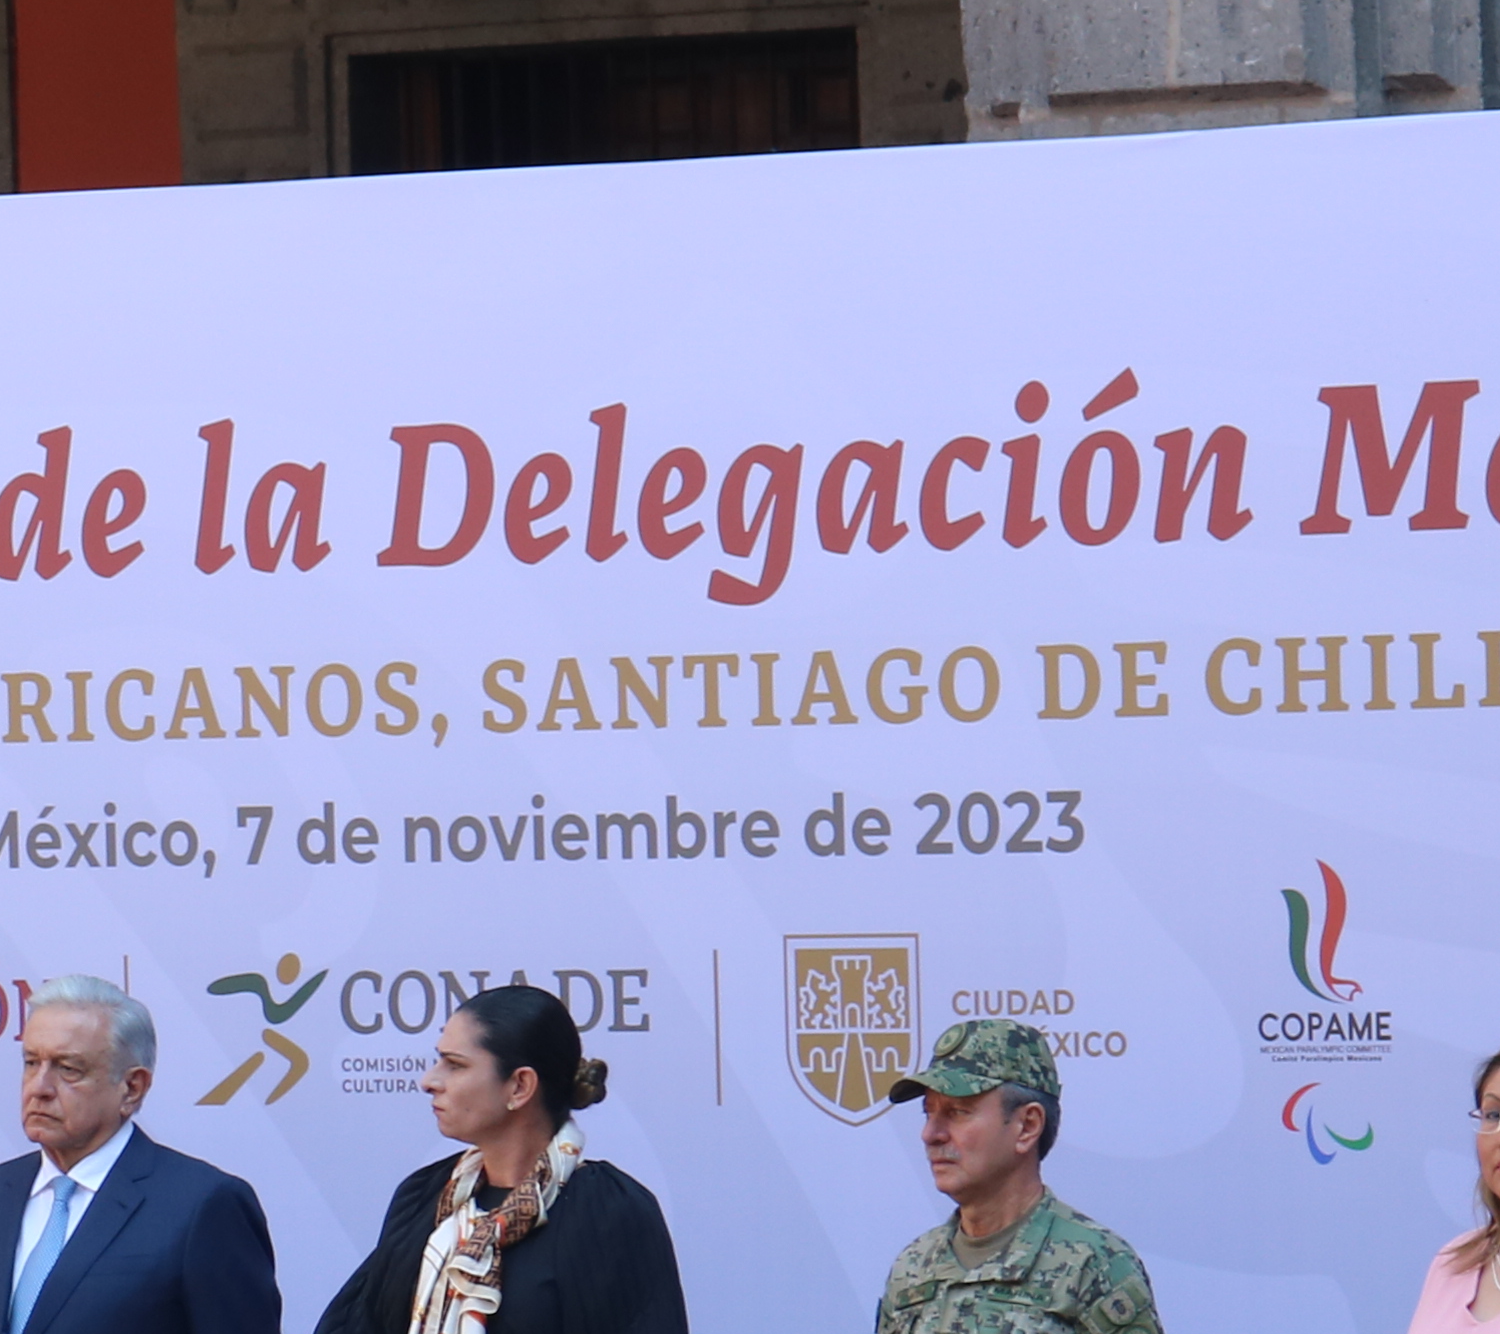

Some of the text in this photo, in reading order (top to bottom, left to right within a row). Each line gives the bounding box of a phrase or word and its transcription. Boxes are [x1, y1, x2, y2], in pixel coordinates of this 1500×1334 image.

[193, 417, 333, 576] la
[375, 365, 1254, 607] Delegación
[482, 645, 1001, 734] SANTIAGO
[1035, 640, 1170, 721] DE
[236, 805, 275, 866] 7
[296, 801, 380, 866] de
[403, 793, 782, 864] noviembre
[803, 791, 892, 858] de
[912, 790, 1085, 856] 2023
[339, 968, 650, 1035] CONDE
[951, 989, 1076, 1017] CIUDAD
[1037, 1024, 1128, 1058] XICO
[1257, 1011, 1393, 1042] COPAME
[341, 1055, 427, 1073] COMISIÓN
[1260, 1044, 1392, 1054] MEXICAN PARALYMPIC COMMITTEE
[341, 1078, 418, 1094] CULTURA
